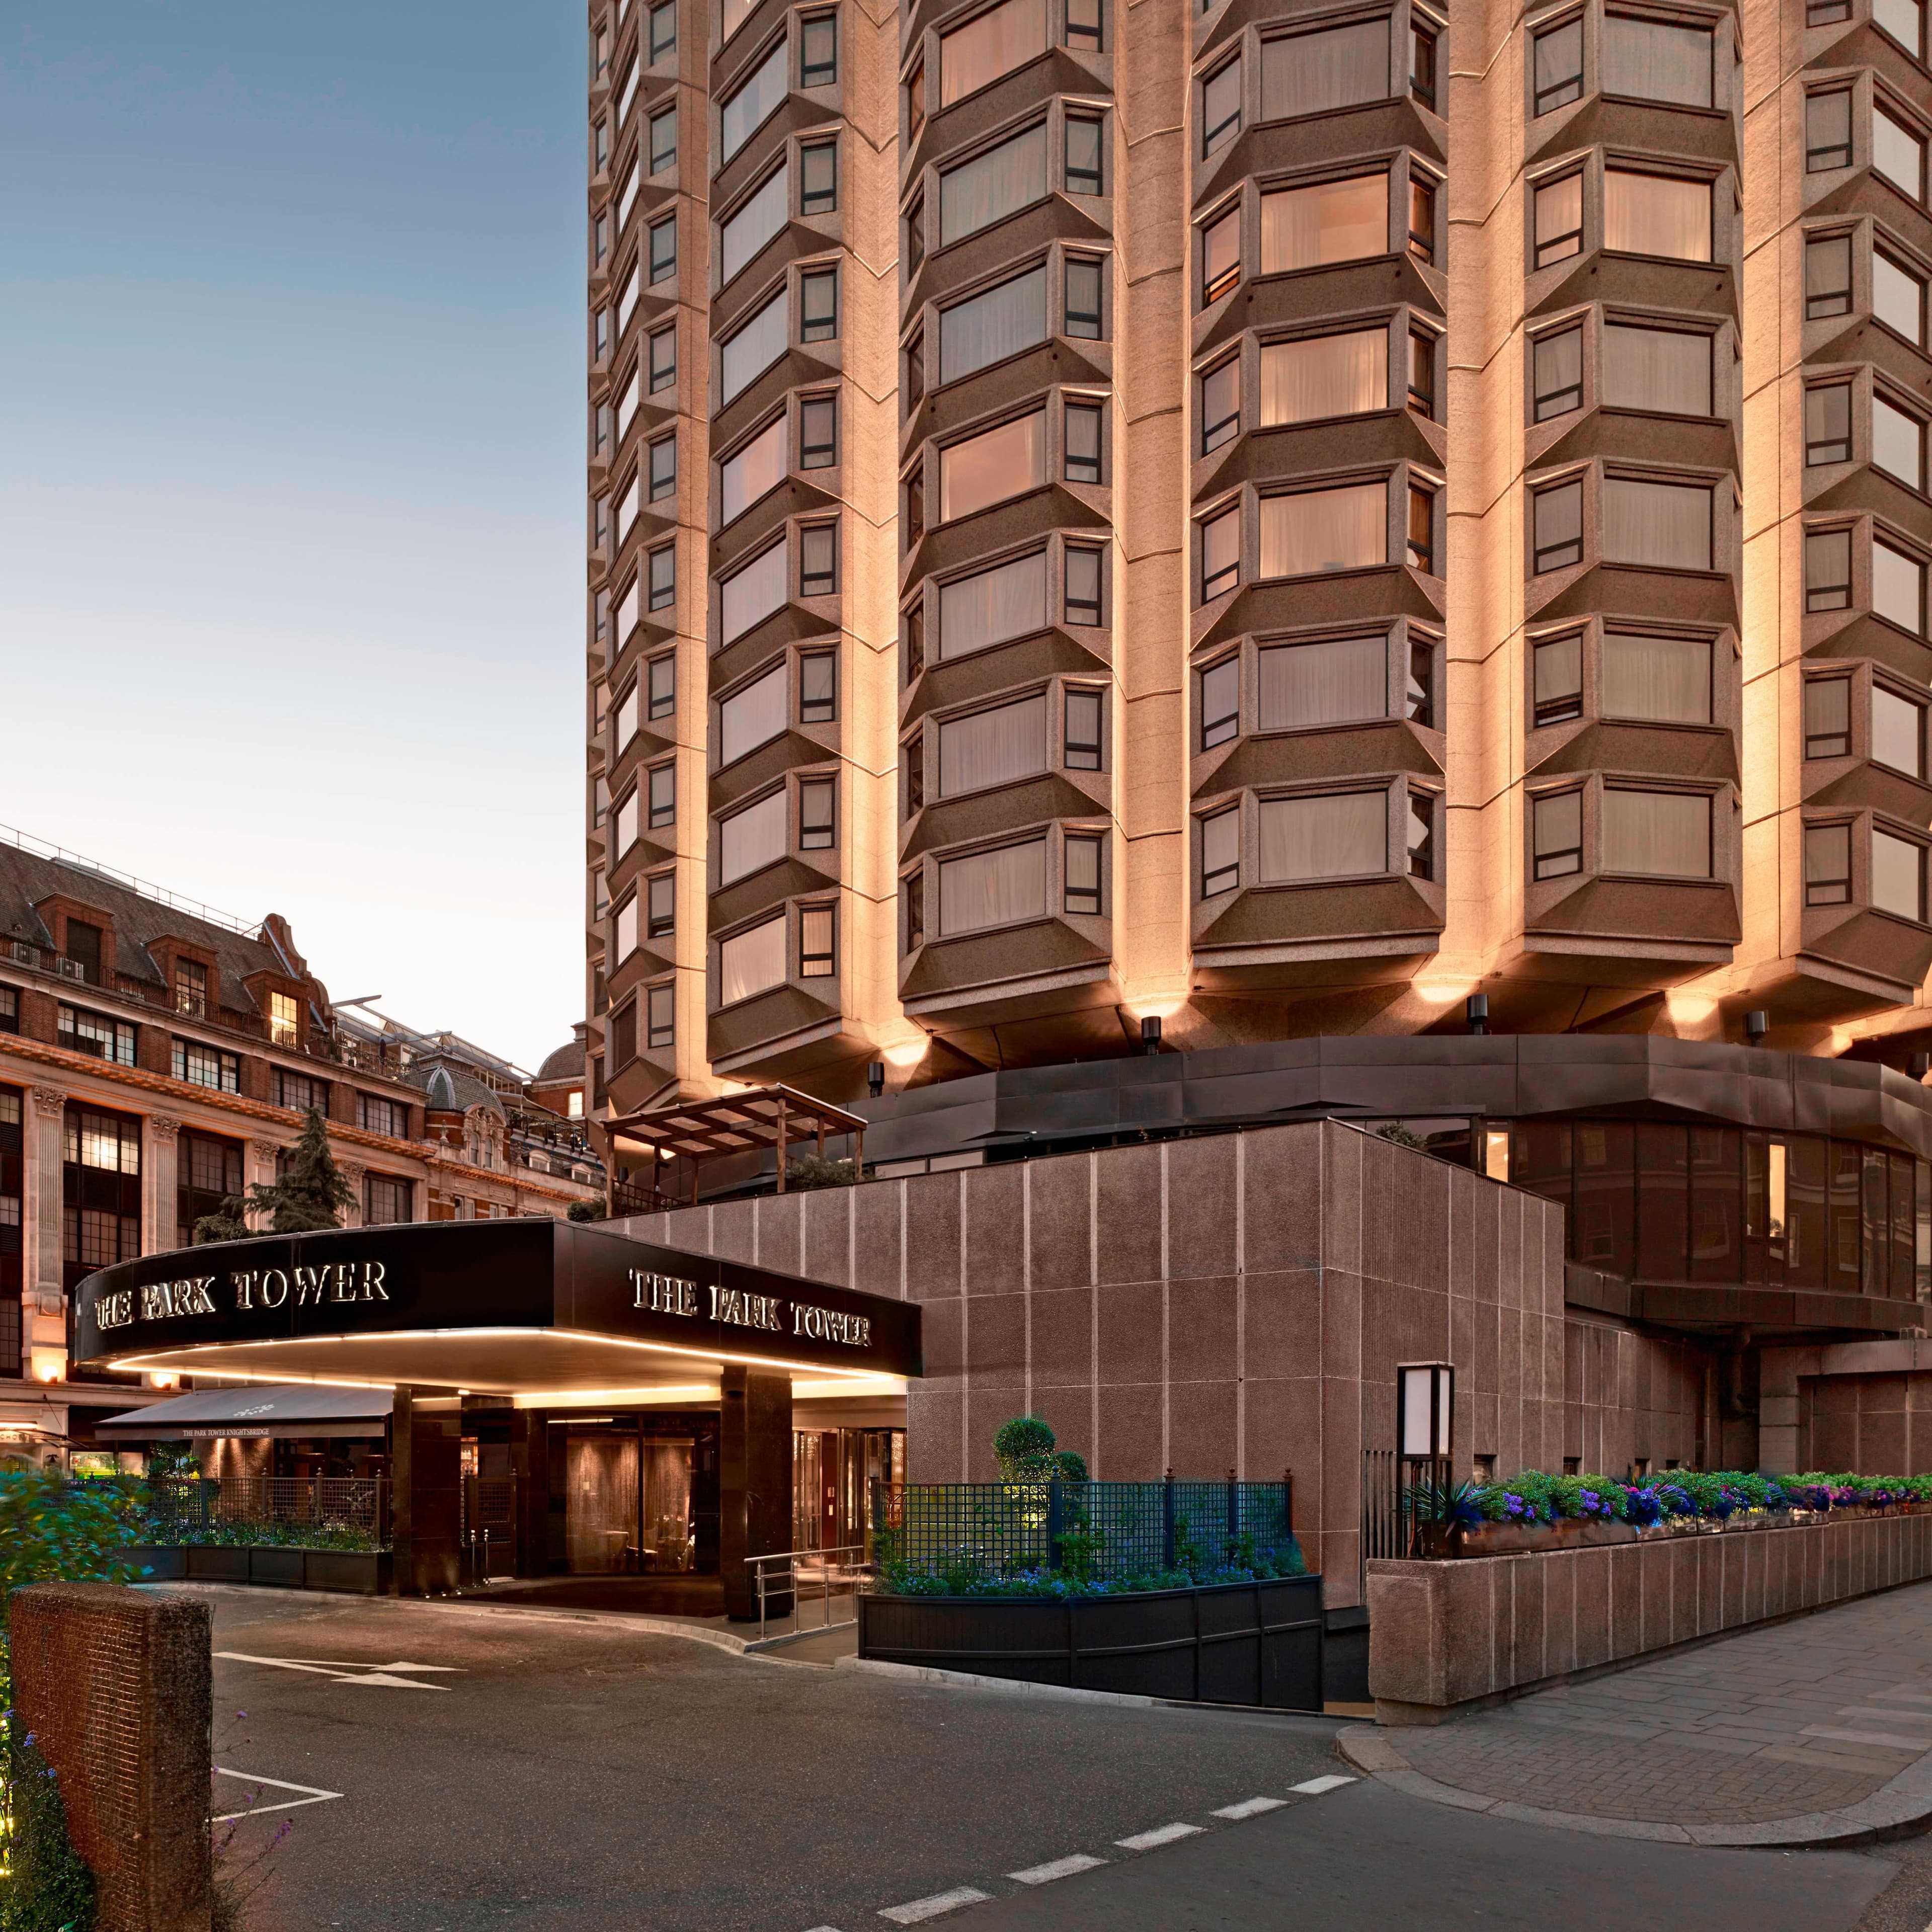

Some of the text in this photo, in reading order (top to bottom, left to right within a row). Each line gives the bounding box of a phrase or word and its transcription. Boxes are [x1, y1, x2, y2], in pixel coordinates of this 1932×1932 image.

[94, 1261, 389, 1330] THE PARK TOWER
[629, 1268, 873, 1347] THE PARK TOWER
